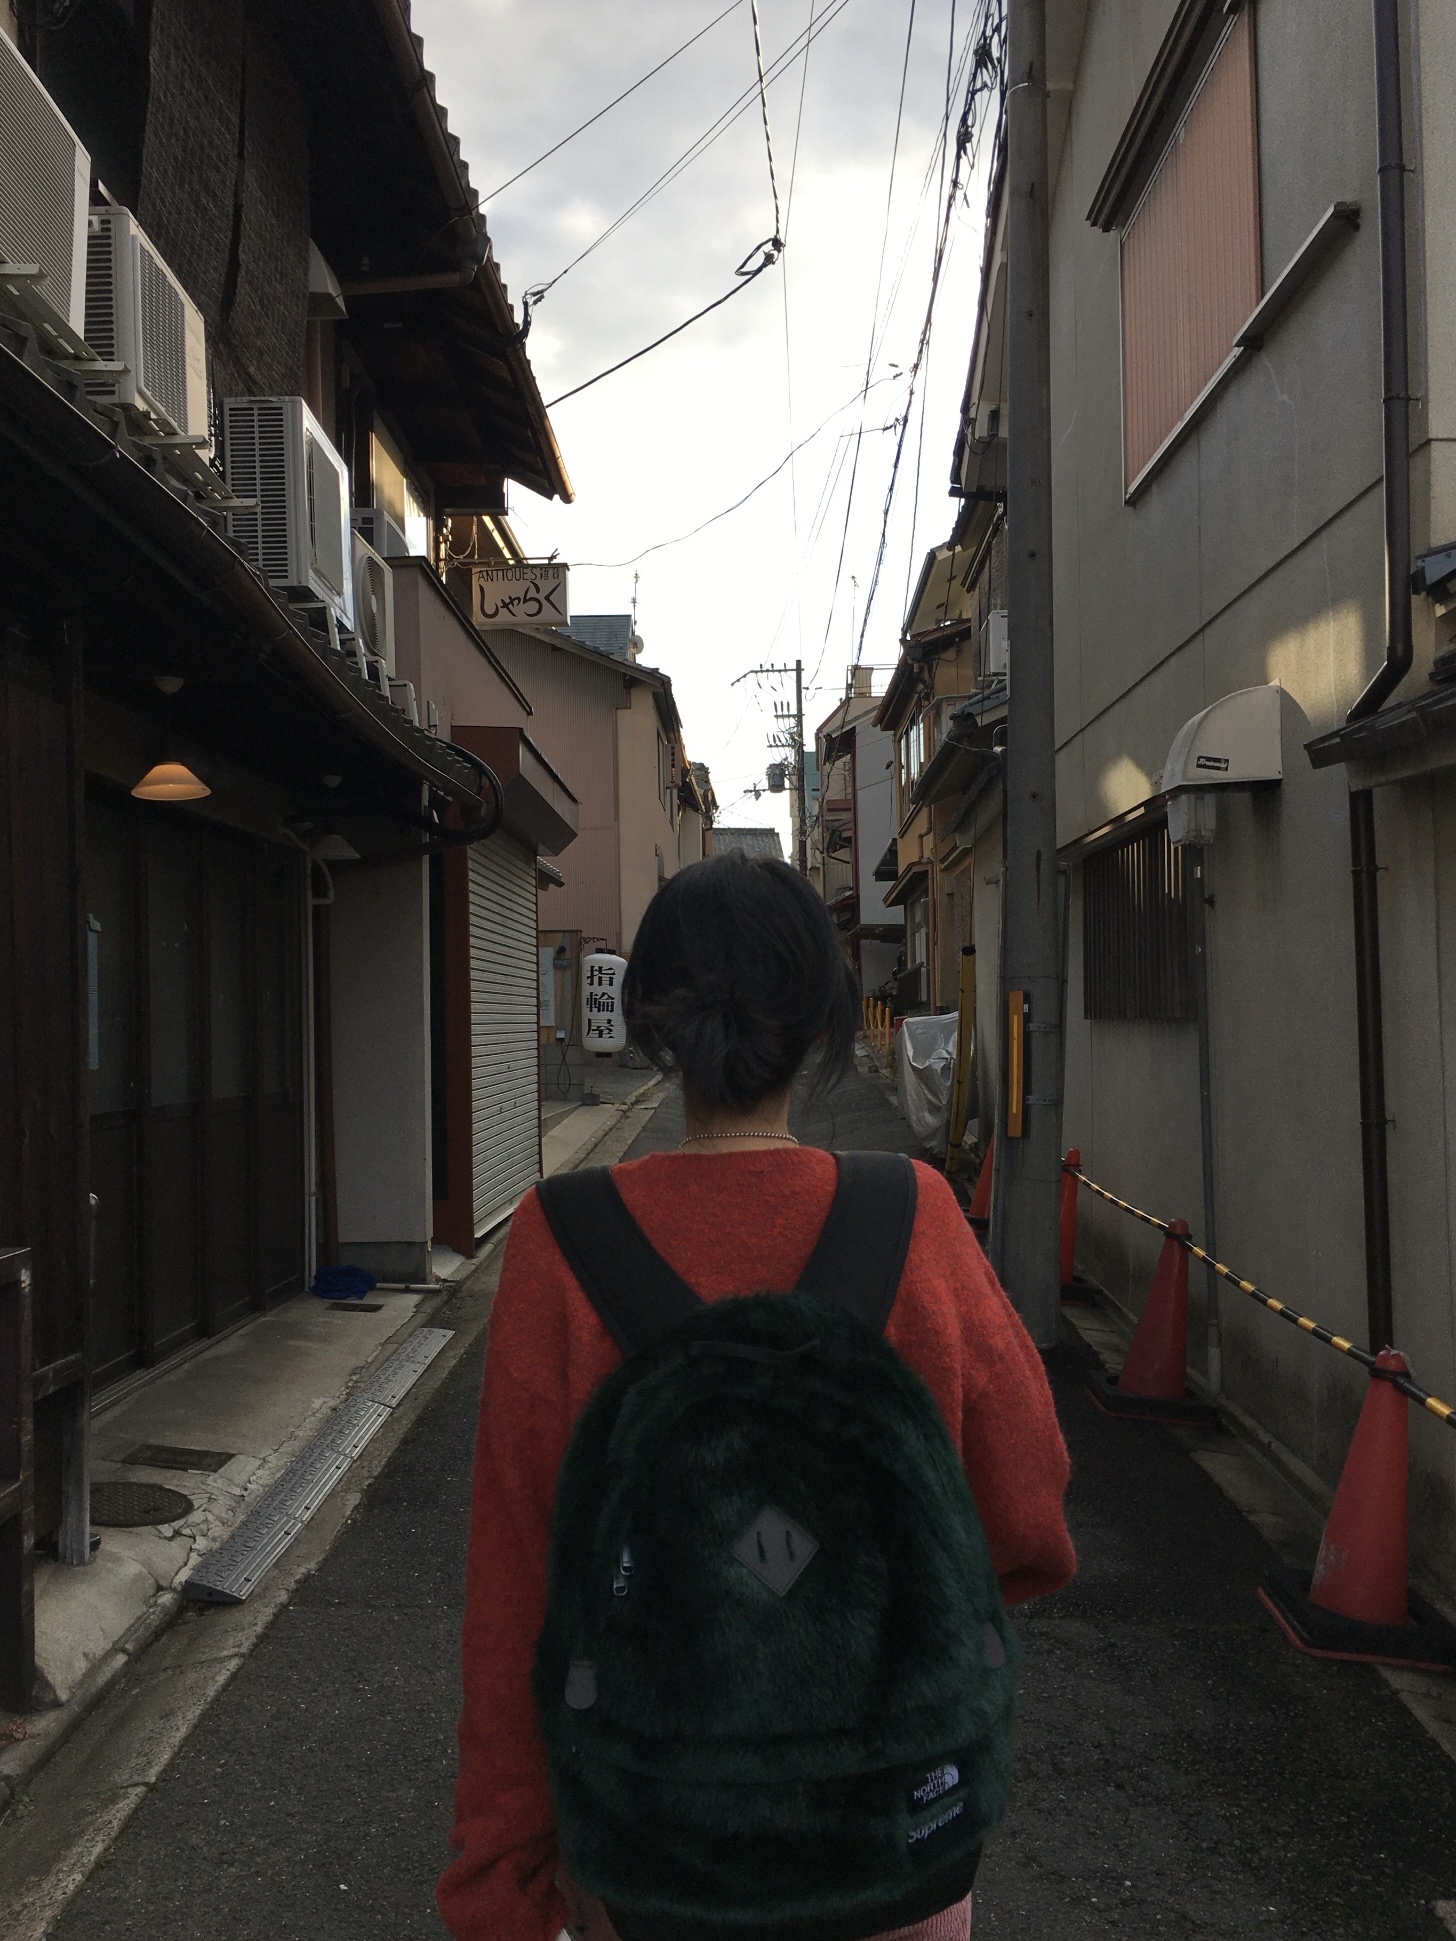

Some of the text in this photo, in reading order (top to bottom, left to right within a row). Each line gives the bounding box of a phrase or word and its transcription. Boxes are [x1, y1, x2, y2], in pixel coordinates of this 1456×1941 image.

[477, 567, 538, 582] ANTIQUES
[479, 581, 563, 619] しゃらく
[586, 965, 616, 1039] 指輪屋
[926, 1767, 944, 1782] THE
[914, 1777, 945, 1800] NORTH
[923, 1785, 945, 1803] FACE
[908, 1802, 963, 1843] Supreme
